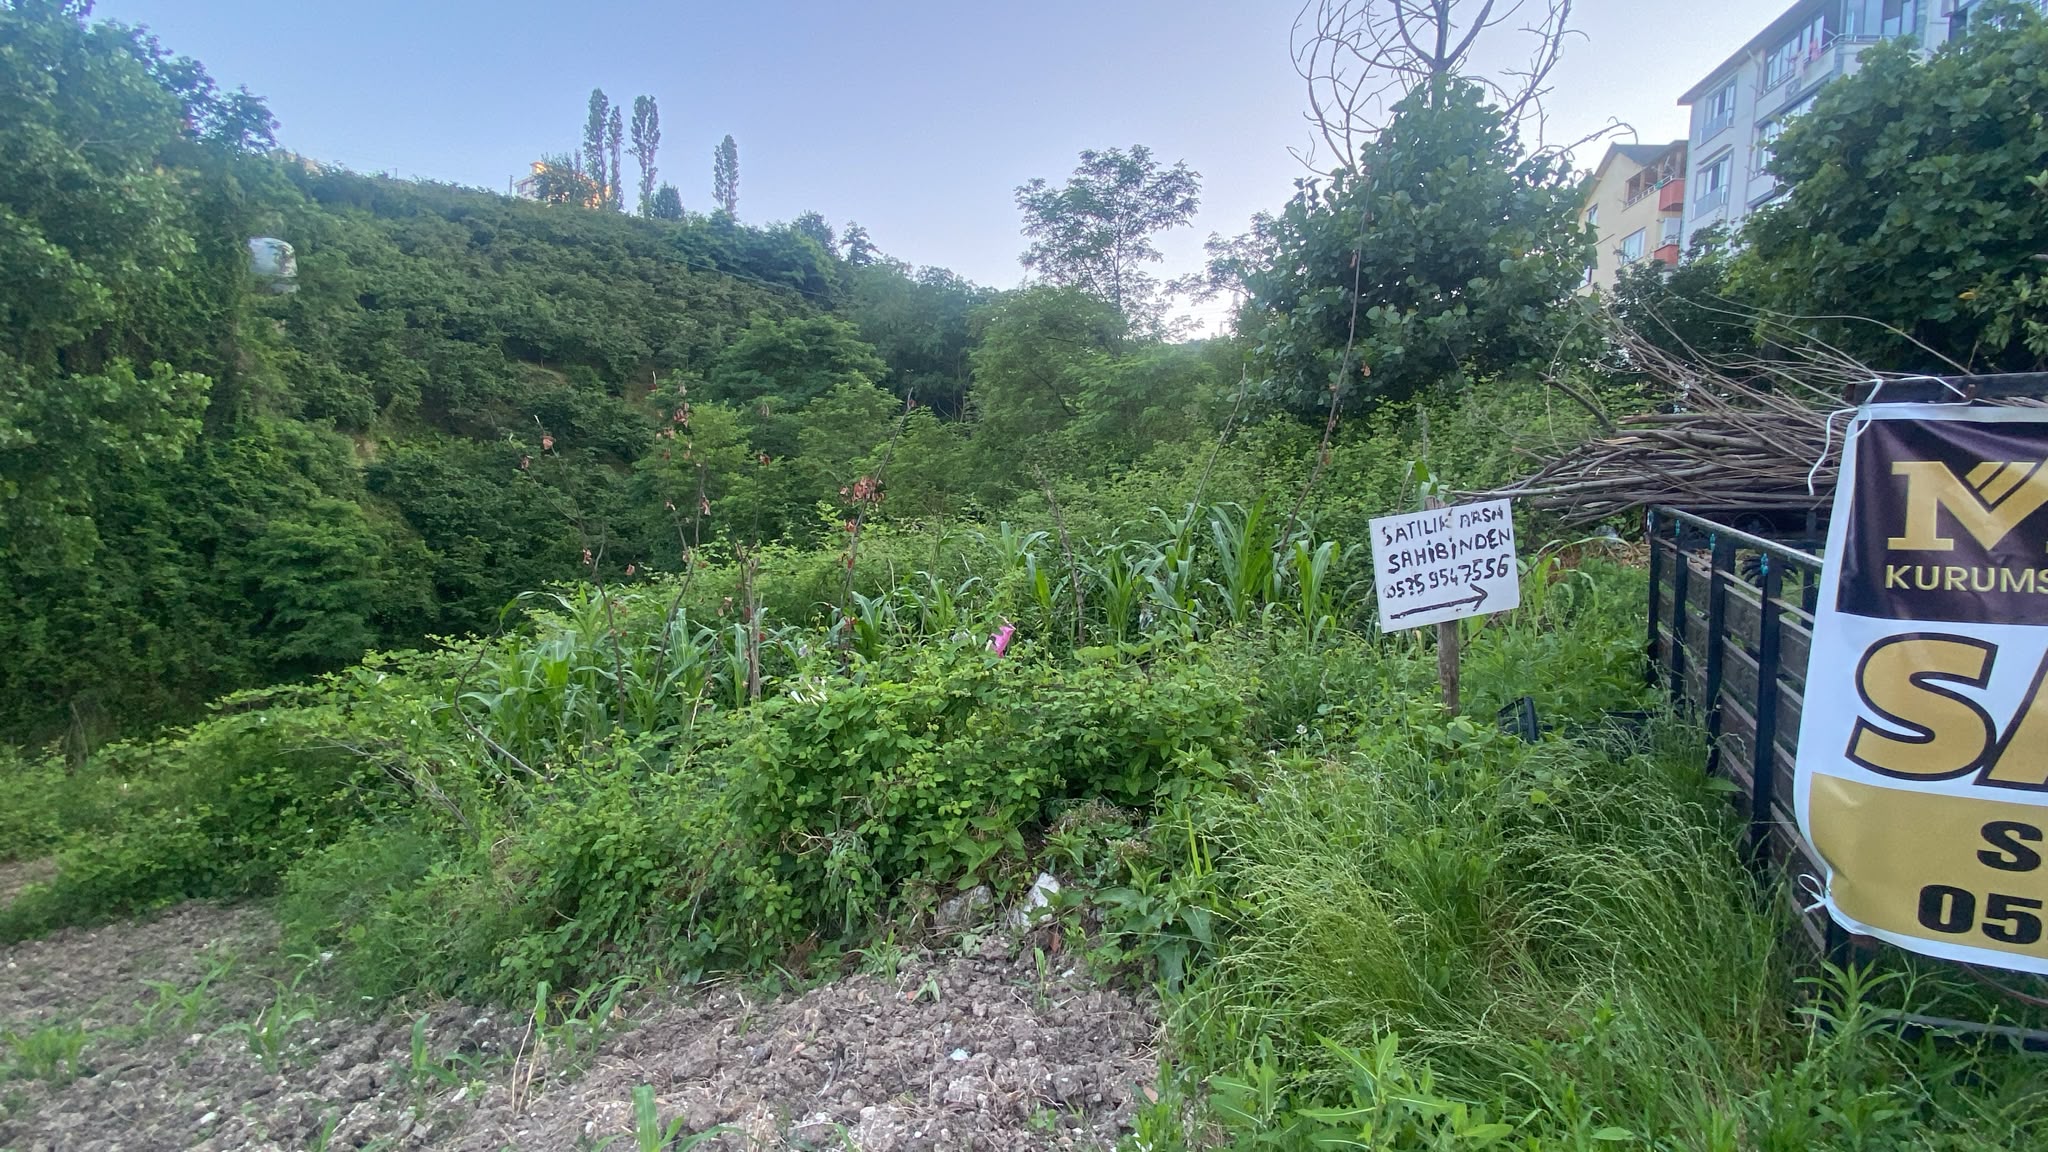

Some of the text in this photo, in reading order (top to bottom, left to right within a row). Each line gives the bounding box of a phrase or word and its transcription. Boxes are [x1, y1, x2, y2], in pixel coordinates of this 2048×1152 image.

[1388, 528, 1511, 574] SAHİBİNDEN
[1976, 820, 2043, 872] S
[1918, 884, 2043, 945] 05
